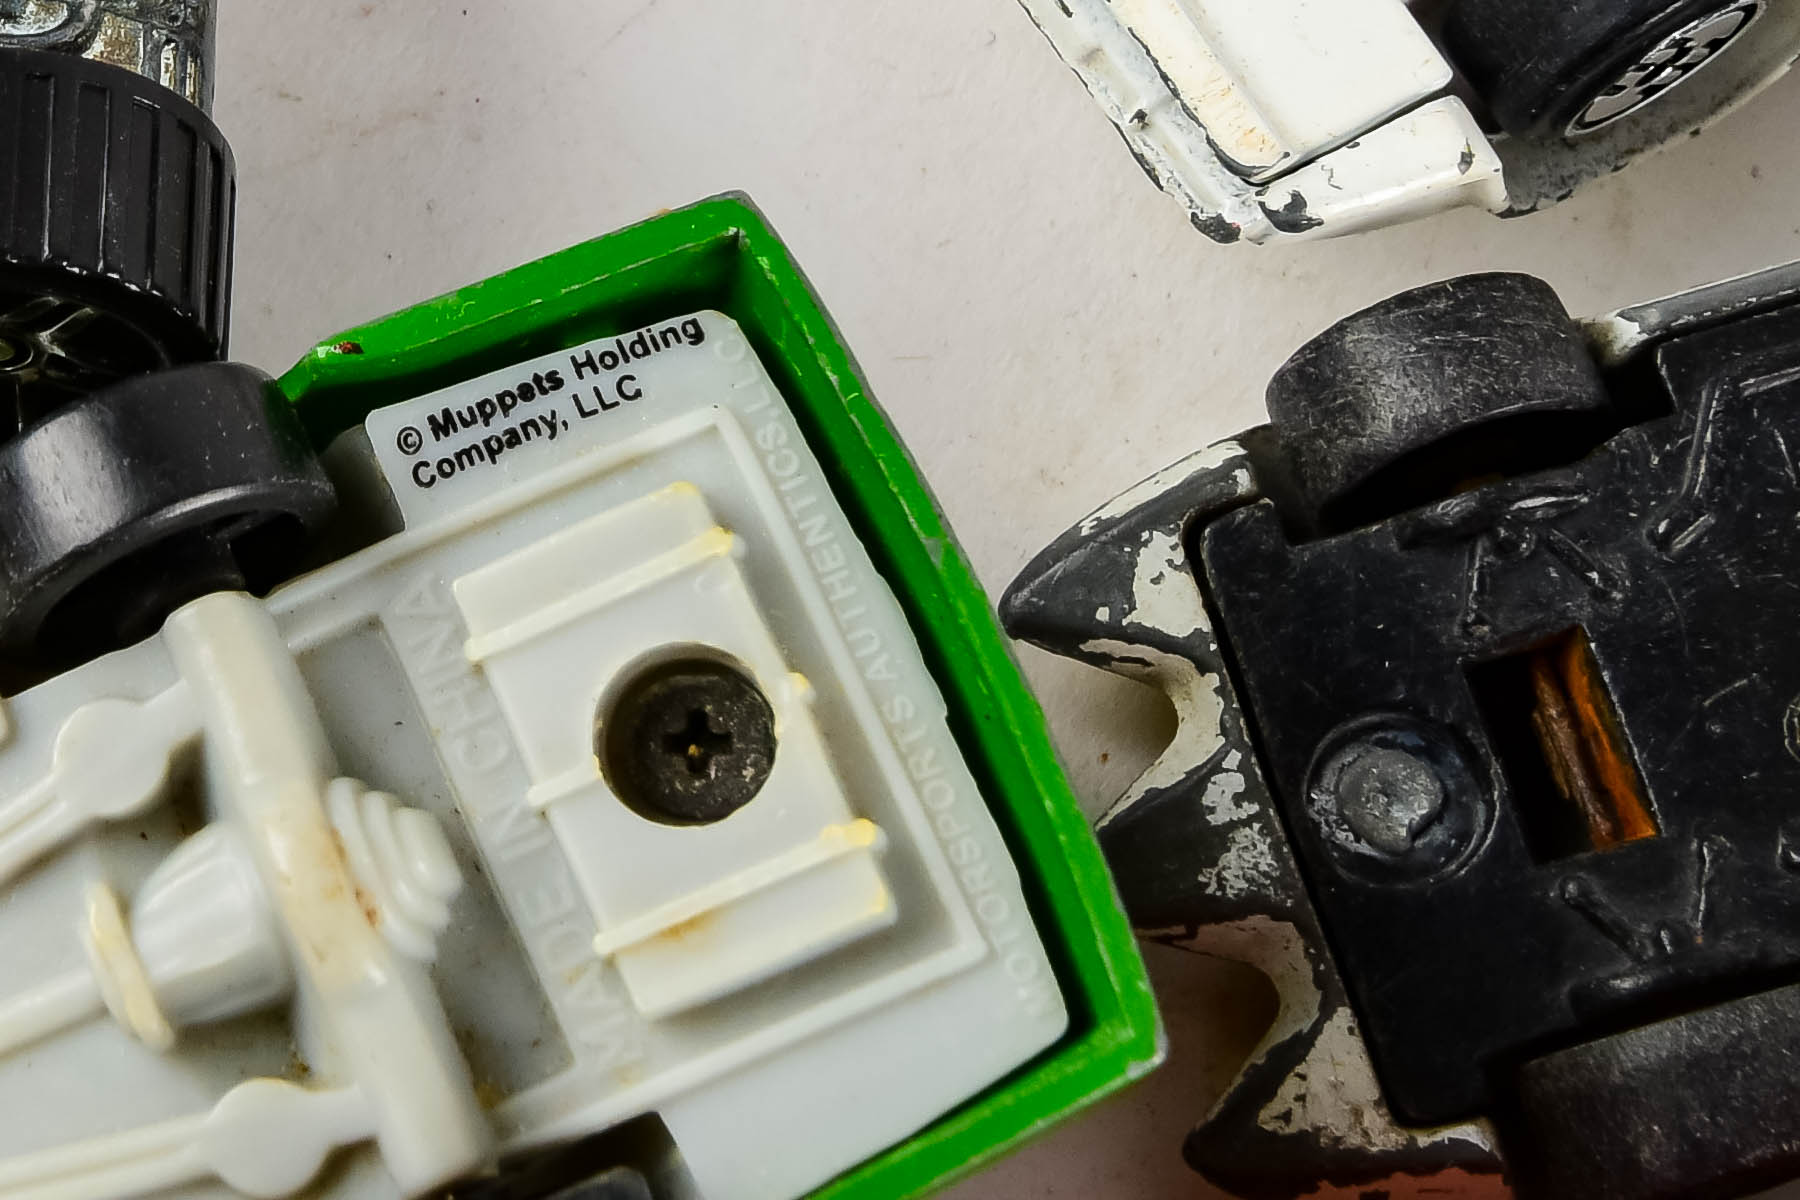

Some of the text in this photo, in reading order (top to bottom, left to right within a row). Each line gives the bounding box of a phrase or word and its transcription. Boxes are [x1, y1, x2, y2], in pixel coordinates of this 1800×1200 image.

[412, 374, 643, 489] Company, LLC
[427, 368, 565, 442] Muppets
[570, 317, 706, 380] Holding
